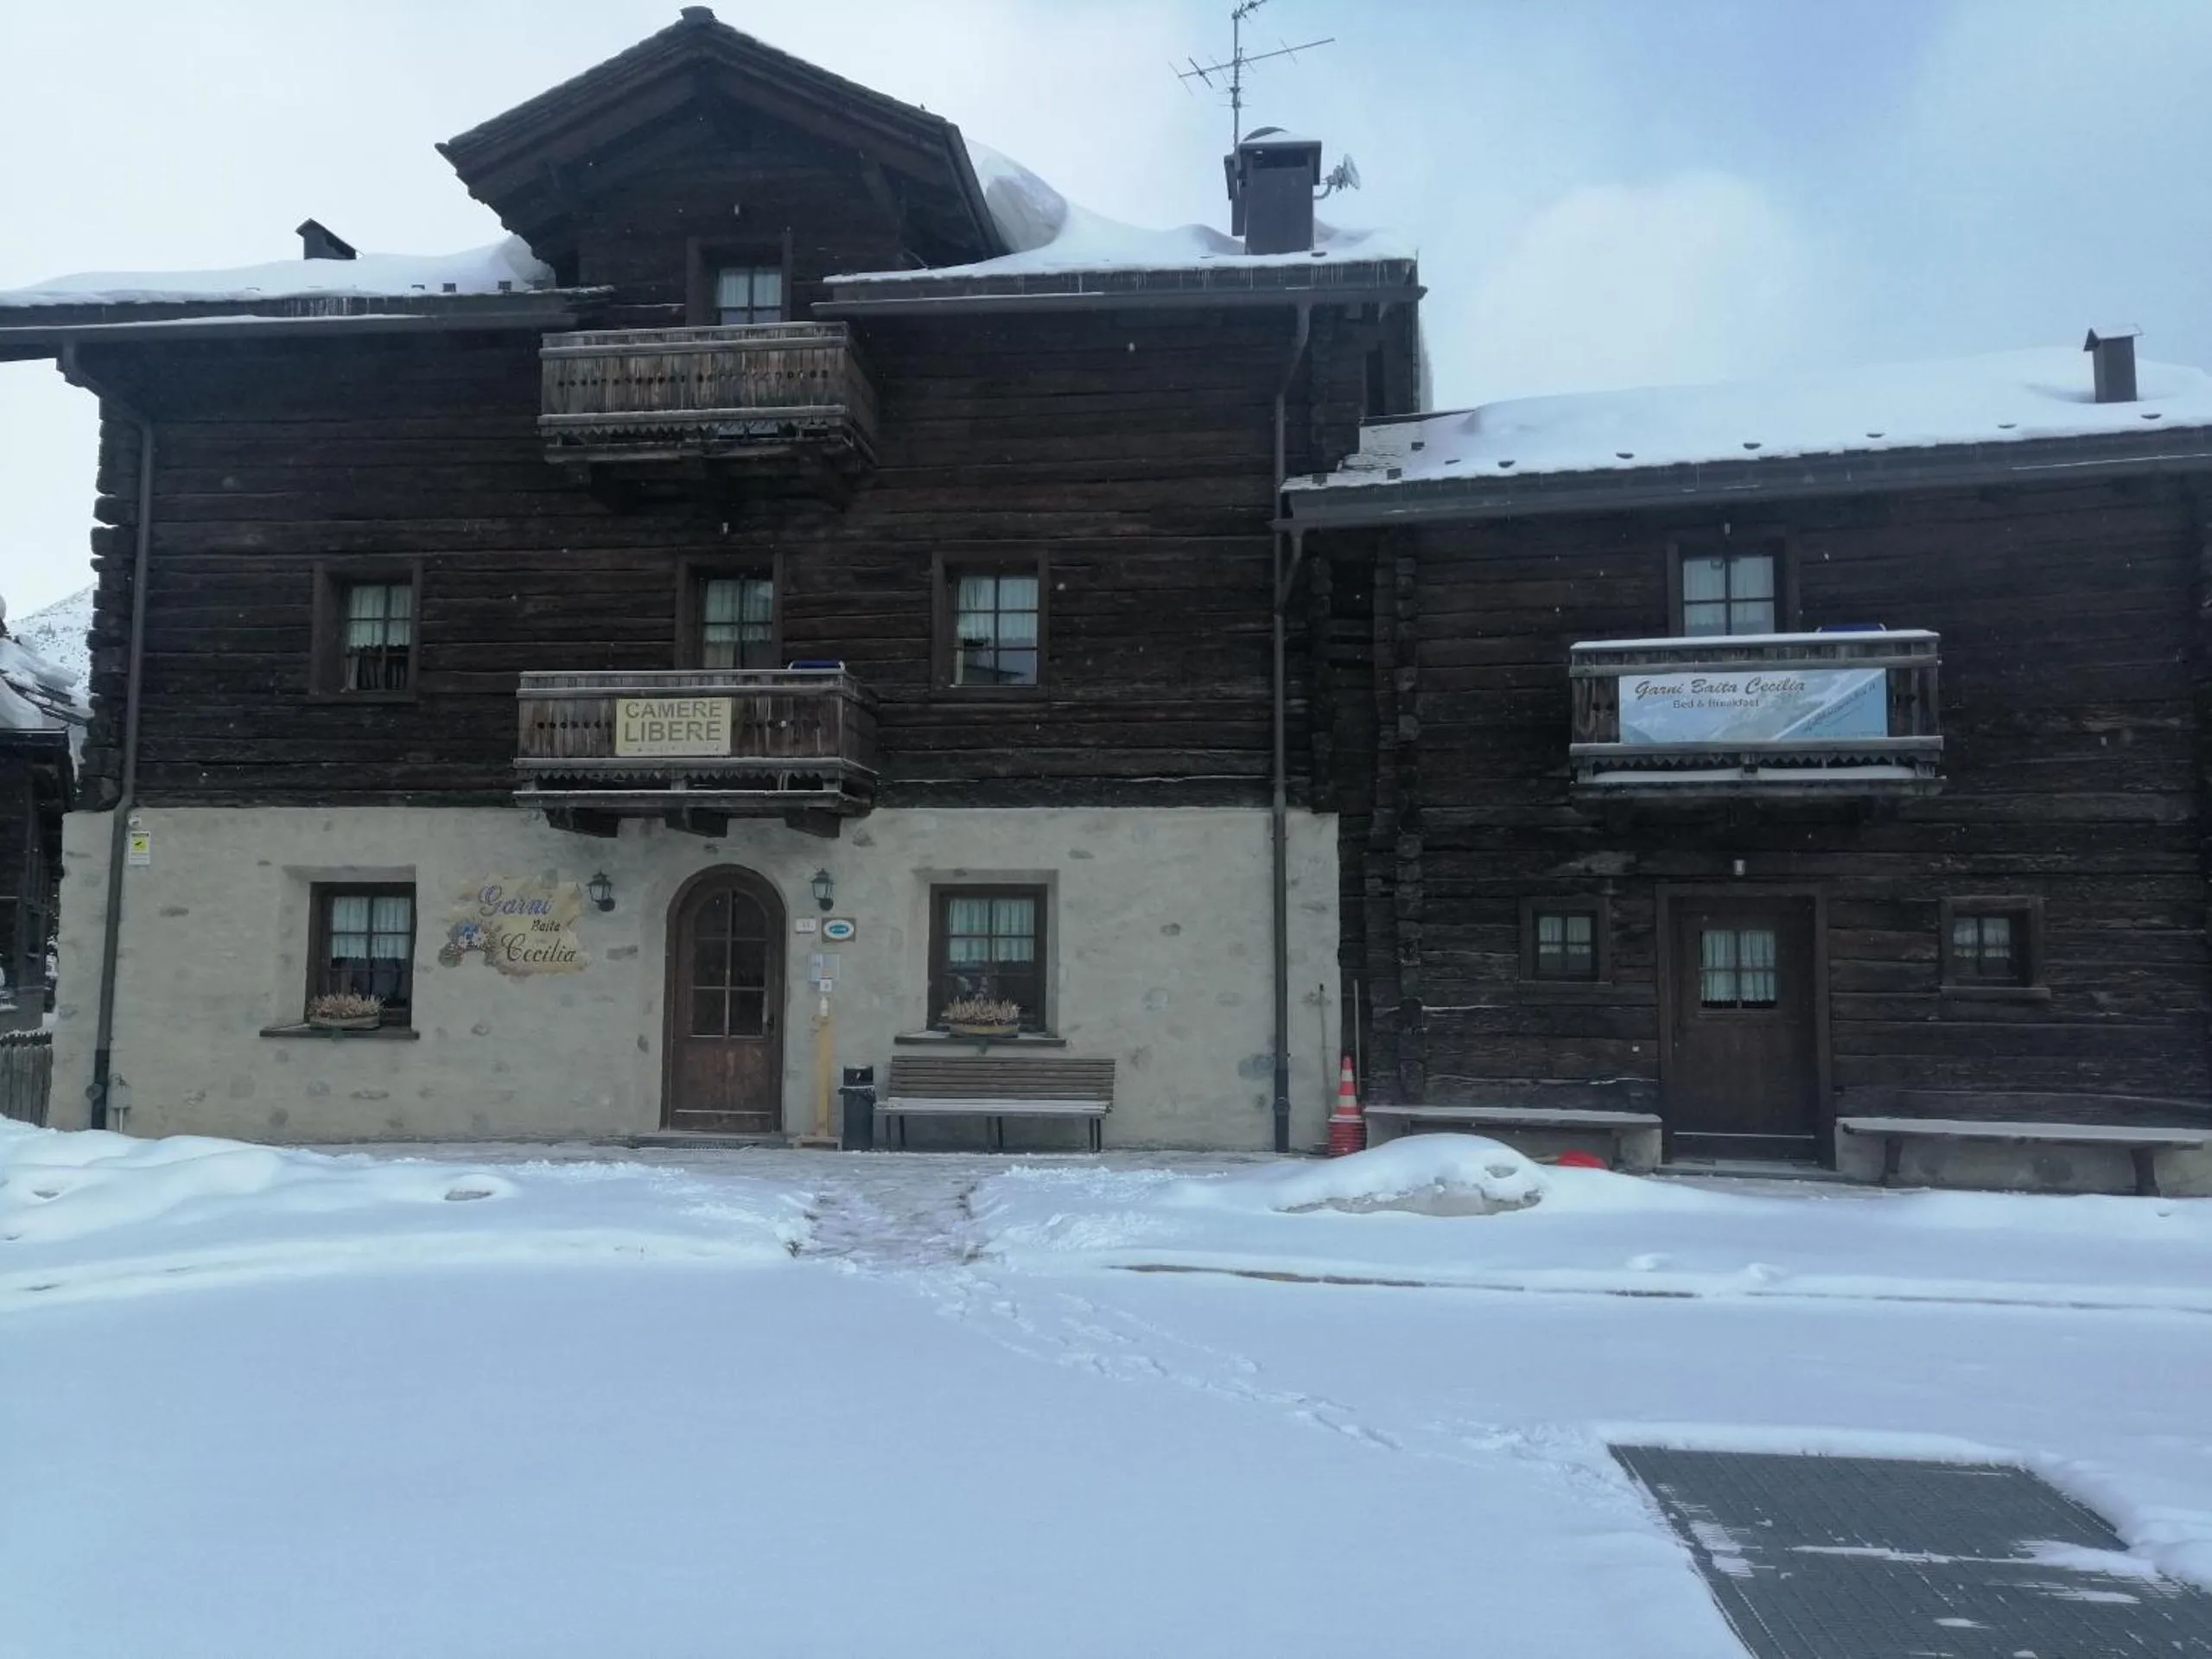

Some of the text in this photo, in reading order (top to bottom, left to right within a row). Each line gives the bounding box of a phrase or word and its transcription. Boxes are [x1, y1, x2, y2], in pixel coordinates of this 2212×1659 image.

[1634, 676, 1806, 701] Garni Baita Cecilia
[625, 701, 722, 719] CAMERE
[1672, 698, 1694, 709] Bed
[625, 721, 721, 742] LIBERE
[478, 884, 552, 917] Garni
[530, 918, 562, 933] Baita
[500, 932, 577, 963] Cecilia
